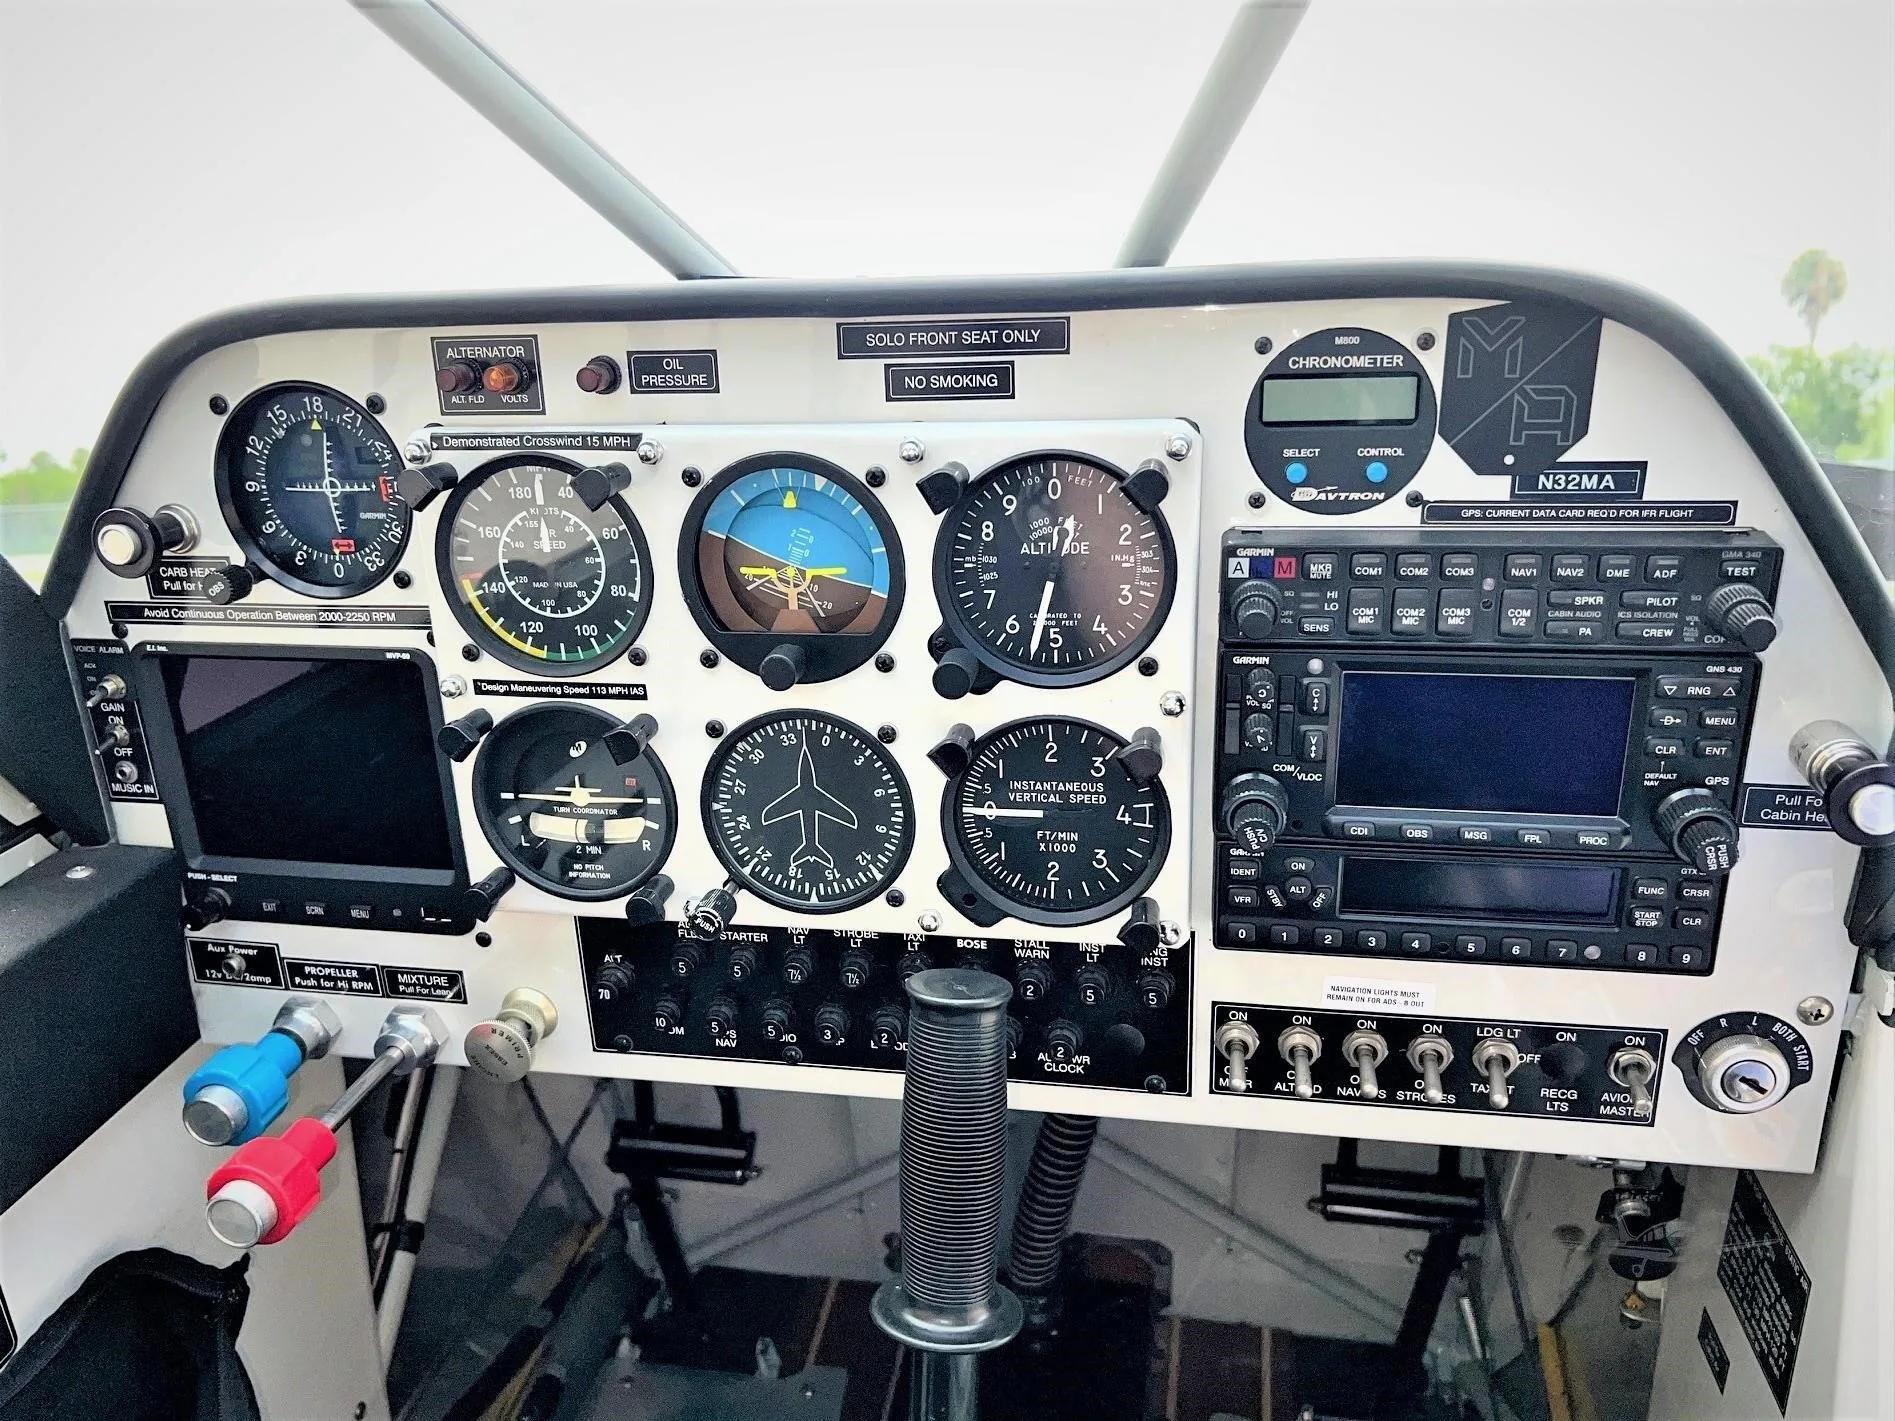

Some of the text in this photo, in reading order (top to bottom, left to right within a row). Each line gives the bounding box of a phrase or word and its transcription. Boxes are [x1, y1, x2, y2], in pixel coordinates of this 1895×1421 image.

[866, 329, 1041, 346] SOLO FRONT SEAT ONLY
[447, 346, 525, 359] ALTERNATOR
[663, 358, 684, 370] OIL
[1289, 355, 1404, 369] CHRONOMETER
[641, 374, 708, 387] PRESSURE
[904, 374, 998, 389] NO SMOKING
[451, 395, 485, 404] ALT. FLD
[501, 394, 529, 403] VOLTS
[443, 436, 631, 447] Demonstrated Crosswind 15 MPH
[1283, 449, 1320, 457] SELECT
[1357, 448, 1405, 456] CONTROL
[1538, 474, 1615, 490] N32MA
[1461, 509, 1694, 519] GPS: CURRENT DATA CARD REQ'D FOR IFR FLIGHT
[1236, 548, 1274, 556] GARMIN
[160, 567, 188, 577] CARB
[1355, 567, 1382, 575] COM1
[1400, 567, 1429, 576] COM2
[1445, 567, 1474, 576] COM3
[1511, 568, 1537, 576] NAV1
[1557, 568, 1584, 577] NAV2
[1606, 569, 1630, 578] DME
[1653, 570, 1677, 578] ADF
[1726, 567, 1756, 576] TEST
[163, 581, 181, 590] Pull
[183, 581, 196, 590] for
[1574, 597, 1603, 606] SPKR
[1646, 597, 1678, 606] PILOT
[144, 608, 396, 623] Avoid Continuous Operation Between 2000-2250 RPM
[1352, 608, 1379, 616] COM1
[1397, 608, 1425, 617] COM2
[1442, 608, 1471, 616] COM3
[1508, 609, 1531, 618] COM
[1633, 611, 1678, 619] ISOLATION
[1303, 624, 1330, 633] SENS
[1578, 628, 1592, 636] PA
[1642, 628, 1673, 637] CREW
[1233, 656, 1270, 665] GARMIN
[481, 683, 645, 696] Design Maneuvering Speed 113 MPH IAS
[1687, 686, 1711, 695] RNG
[100, 703, 125, 712] GAIN
[108, 716, 124, 725] ON
[1705, 717, 1736, 726] MENU
[114, 748, 133, 757] OFF
[1655, 746, 1676, 754] CLR
[1705, 747, 1727, 756] ENT
[1010, 781, 1104, 792] INSTANTANEOUS
[1705, 777, 1729, 786] GPS
[112, 783, 154, 793] MUSIC IN
[1008, 793, 1107, 804] VERTICAL SPEED
[1775, 794, 1823, 806] Pull Fo
[573, 807, 618, 815] COORDINATOR
[1760, 808, 1801, 821] Cabin
[1036, 831, 1078, 841] FT/MIN
[1350, 827, 1368, 835] CDI
[1407, 829, 1428, 838] OBS
[1464, 831, 1487, 840] MSG
[1524, 835, 1542, 844] FPL
[1579, 836, 1607, 846] PROC
[585, 845, 602, 854] MIN
[1039, 843, 1077, 853] X1000
[1291, 862, 1306, 870] ON
[569, 871, 611, 879] INFORMATION
[1231, 868, 1256, 876] IDENT
[1290, 885, 1306, 893] ALT
[1638, 886, 1664, 895] FUNC
[1683, 888, 1710, 897] CRSR
[1234, 896, 1251, 904] VFR
[1266, 888, 1283, 909] STBY
[1682, 917, 1701, 926] CLR
[719, 931, 768, 943] STARTER
[833, 928, 879, 939] STROBE
[794, 935, 805, 945] LT
[850, 938, 862, 948] LT
[956, 939, 988, 950] BOSE
[1014, 939, 1049, 950] STALL
[208, 943, 258, 956] Aux Power
[908, 941, 920, 951] LT
[1014, 948, 1049, 959] WARN
[1086, 953, 1099, 963] LT
[1141, 957, 1168, 967] INST
[304, 966, 358, 978] PROPELLER
[295, 977, 373, 991] Push for Hi RPM
[398, 975, 449, 987] MIXTURE
[399, 985, 414, 995] Pull
[416, 986, 429, 995] For
[1331, 985, 1372, 994] NAVIGATION
[1326, 993, 1353, 1001] REMAIN
[1229, 1011, 1248, 1021] ON
[1292, 1015, 1312, 1025] ON
[1357, 1019, 1377, 1030] ON
[1422, 1024, 1442, 1034] ON
[1476, 1027, 1521, 1039] LDG LT
[1556, 1031, 1577, 1042] ON
[1771, 1022, 1796, 1043] BOTH
[715, 1037, 738, 1048] NAV
[1624, 1035, 1645, 1046] ON
[1688, 1029, 1705, 1047] OFF
[1517, 1053, 1542, 1064] OFF
[1793, 1044, 1809, 1071] START
[1044, 1062, 1085, 1074] CLOCK
[1540, 1088, 1578, 1100] RECG
[1546, 1101, 1569, 1112] LTS
